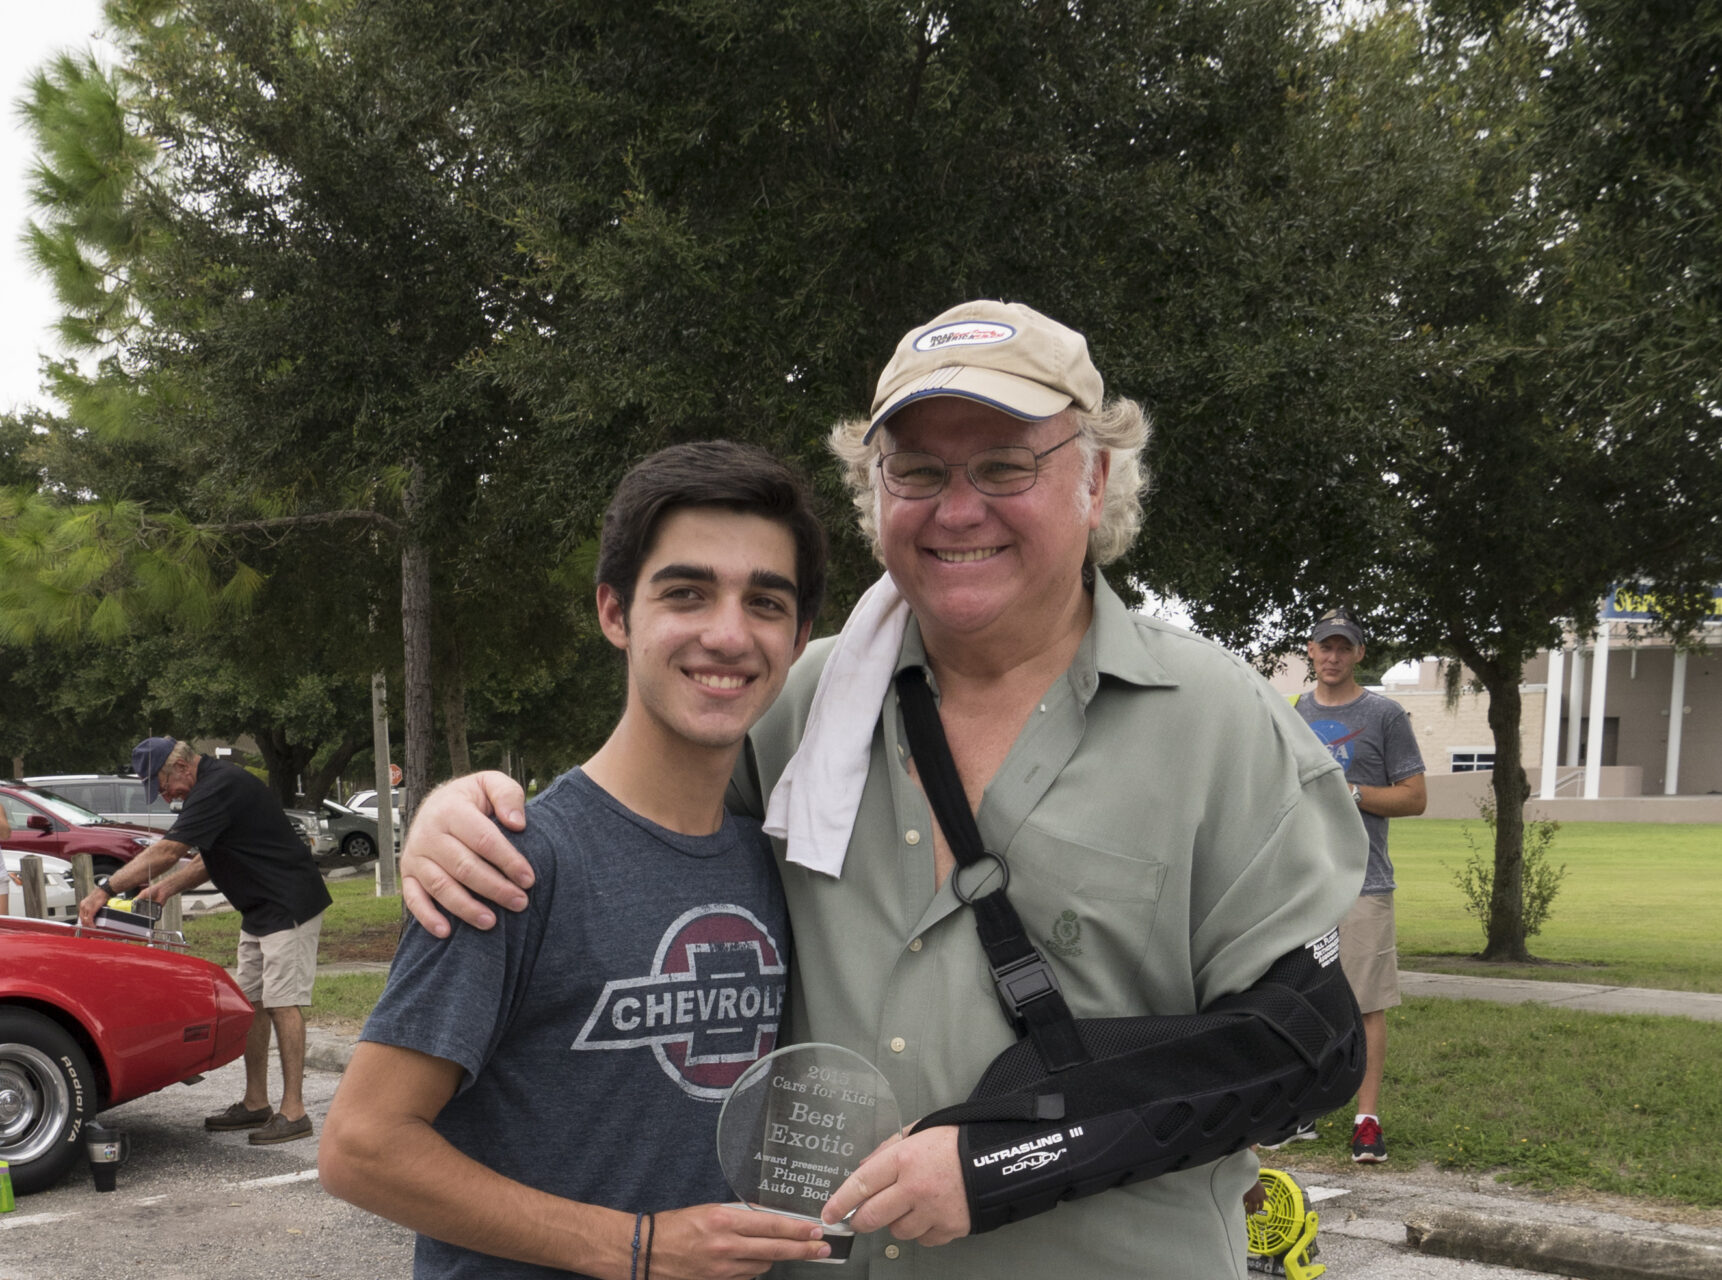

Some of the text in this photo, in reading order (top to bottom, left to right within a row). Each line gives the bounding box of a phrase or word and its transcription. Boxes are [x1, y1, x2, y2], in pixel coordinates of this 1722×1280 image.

[611, 985, 786, 1031] CHEVROLE
[61, 1056, 84, 1112] Radial
[772, 1075, 876, 1107] Cars for Kids
[788, 1101, 846, 1131] Best
[767, 1122, 855, 1157] Exotic
[973, 1126, 1084, 1168] ULTRASLING III
[754, 1151, 854, 1177] Award presented b
[772, 1166, 831, 1188] Pinellas
[757, 1178, 833, 1201] Auto Bod
